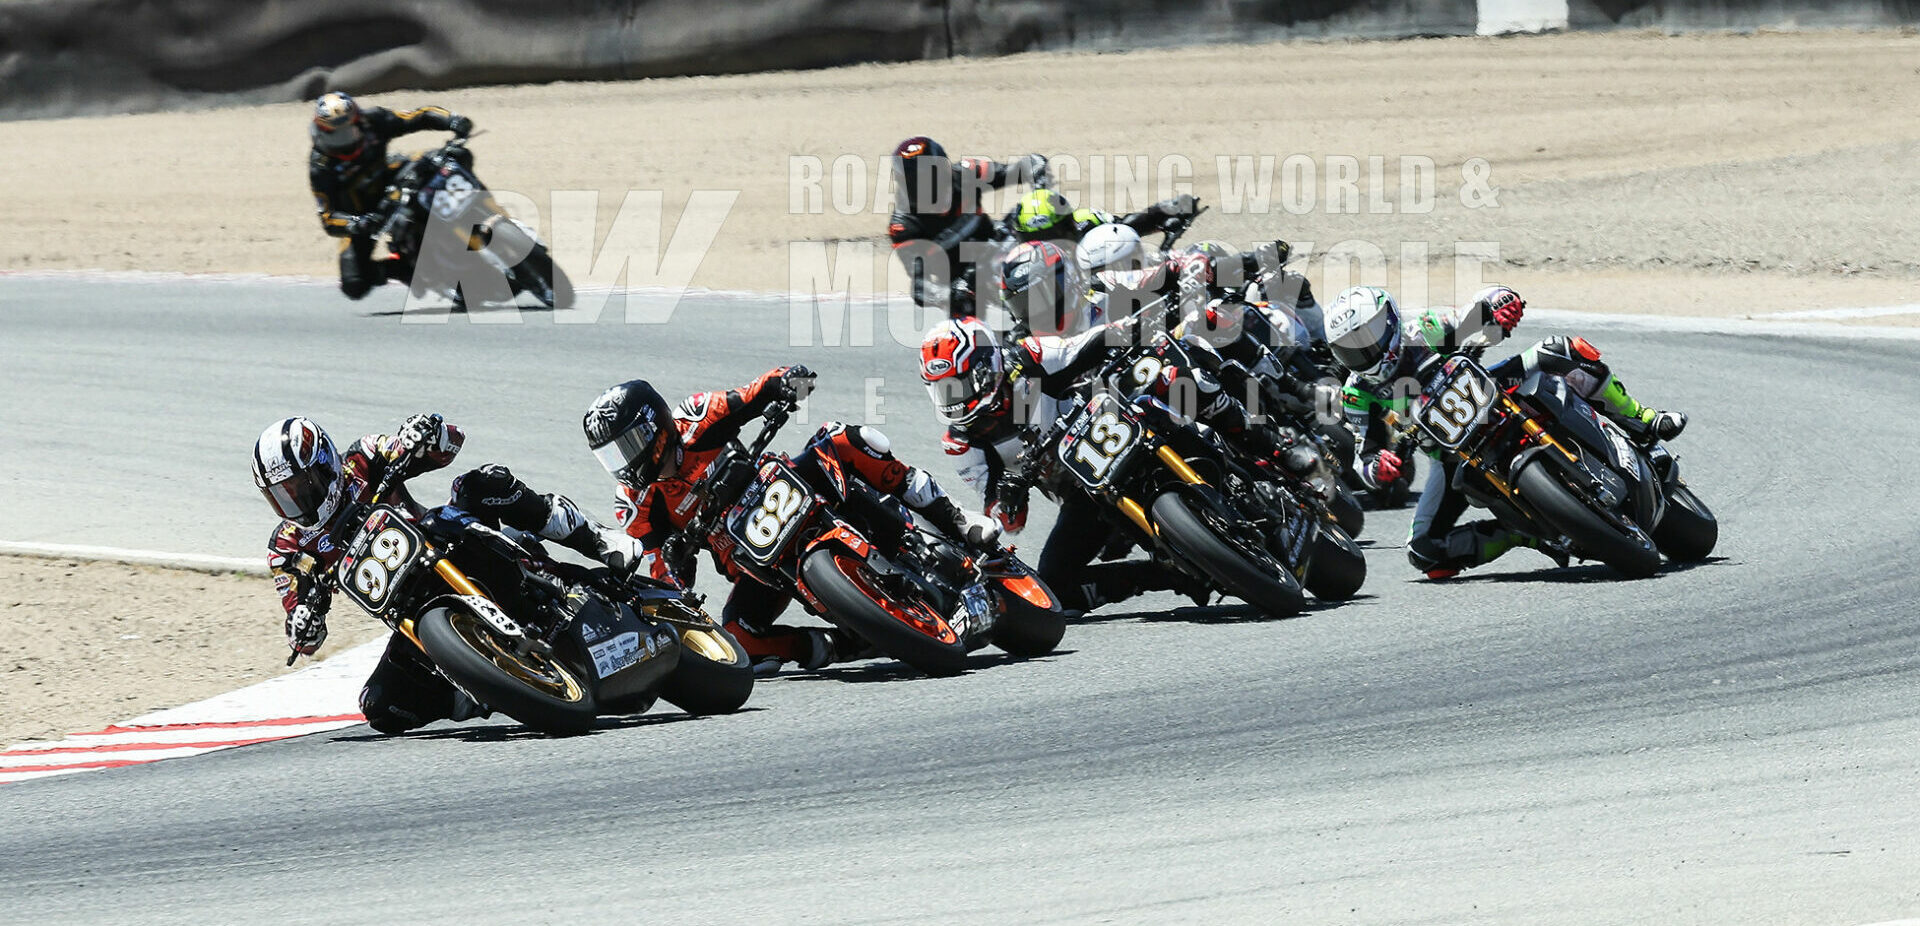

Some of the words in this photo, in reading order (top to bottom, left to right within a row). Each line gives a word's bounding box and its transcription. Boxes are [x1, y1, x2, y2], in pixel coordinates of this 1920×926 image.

[1428, 367, 1489, 443] 137
[264, 461, 292, 479] SHARK
[1075, 412, 1132, 479] 13
[745, 479, 802, 548] 62
[354, 527, 410, 602] 99
